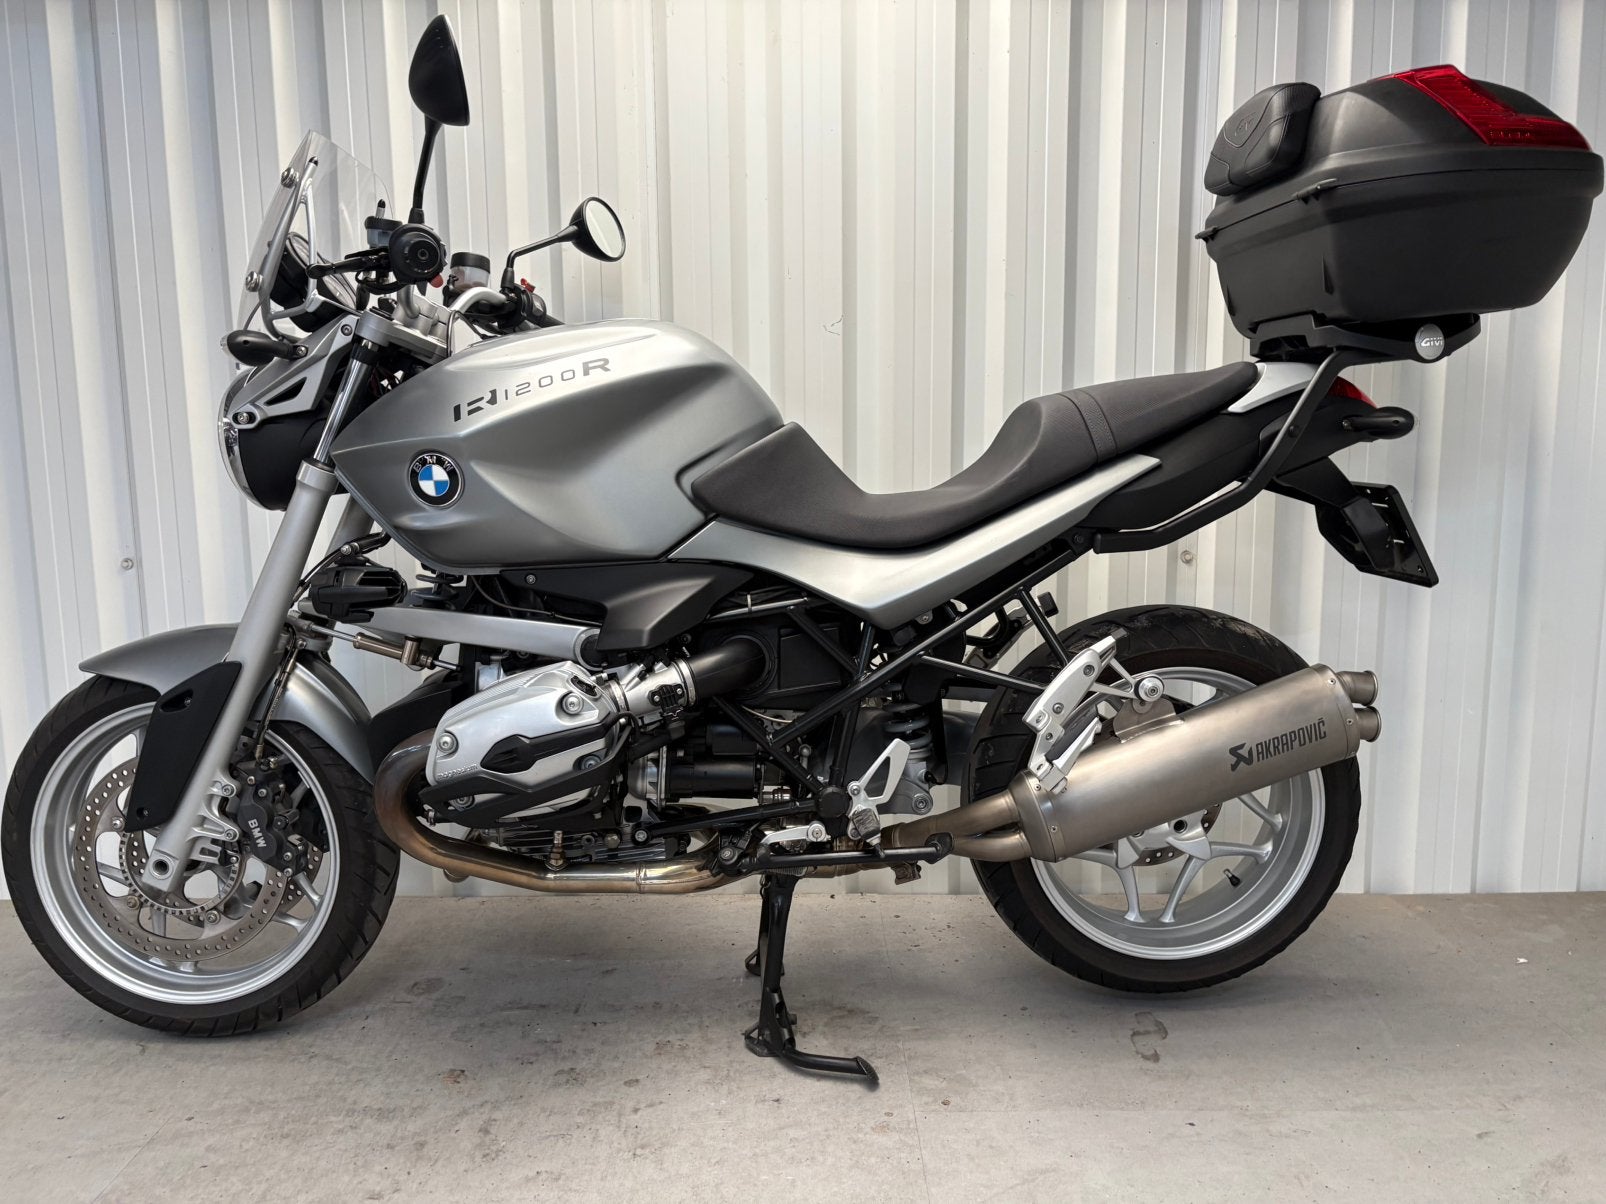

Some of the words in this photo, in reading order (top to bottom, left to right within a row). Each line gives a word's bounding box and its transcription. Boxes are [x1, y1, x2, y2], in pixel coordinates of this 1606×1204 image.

[1421, 336, 1443, 346] GIVI
[413, 455, 454, 472] BMW
[248, 818, 267, 848] BMW
